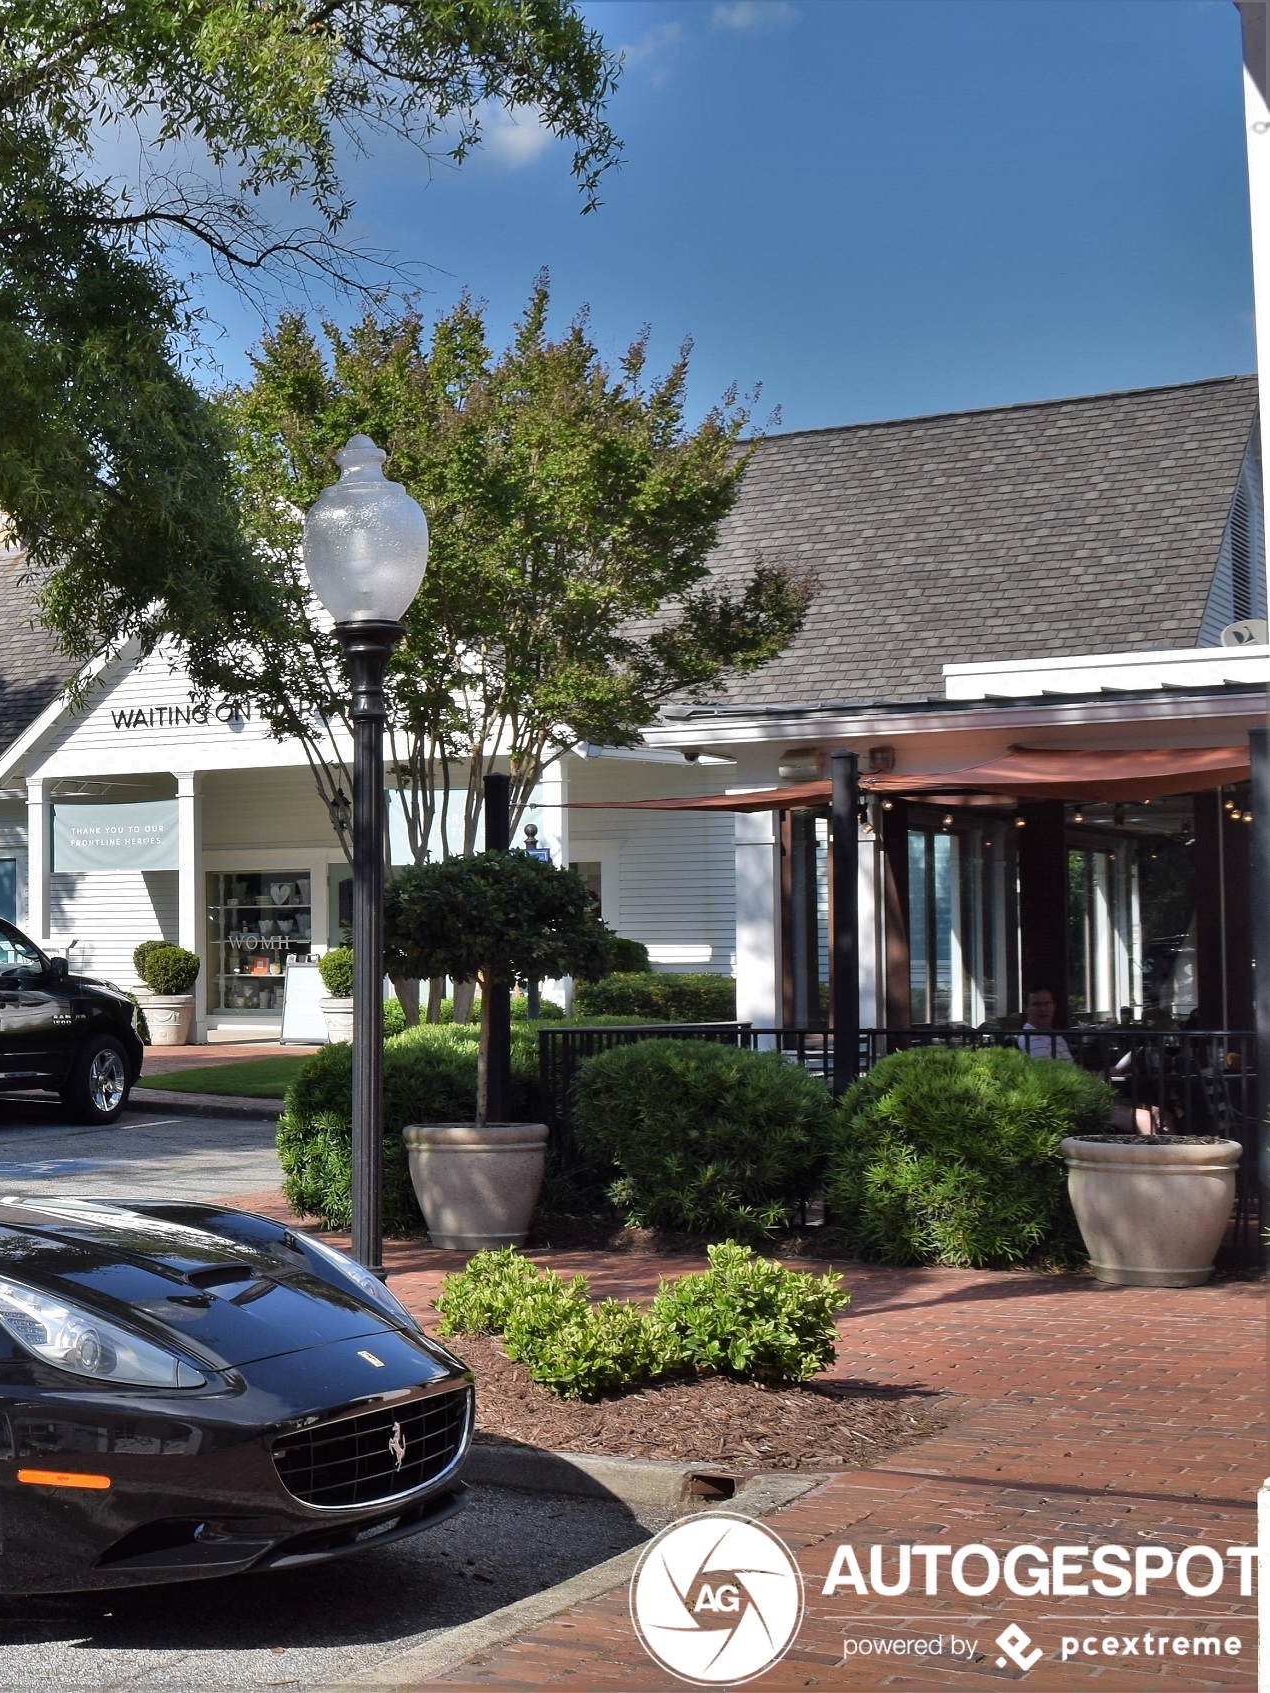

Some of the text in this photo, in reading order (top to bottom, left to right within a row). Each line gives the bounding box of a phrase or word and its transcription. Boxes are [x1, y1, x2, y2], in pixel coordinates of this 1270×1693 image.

[111, 704, 210, 729] WAITING
[215, 699, 250, 722] ON
[71, 825, 164, 835] THANK YOU TO OUR
[70, 838, 121, 847] FRONTLINE
[228, 935, 290, 950] WOMH
